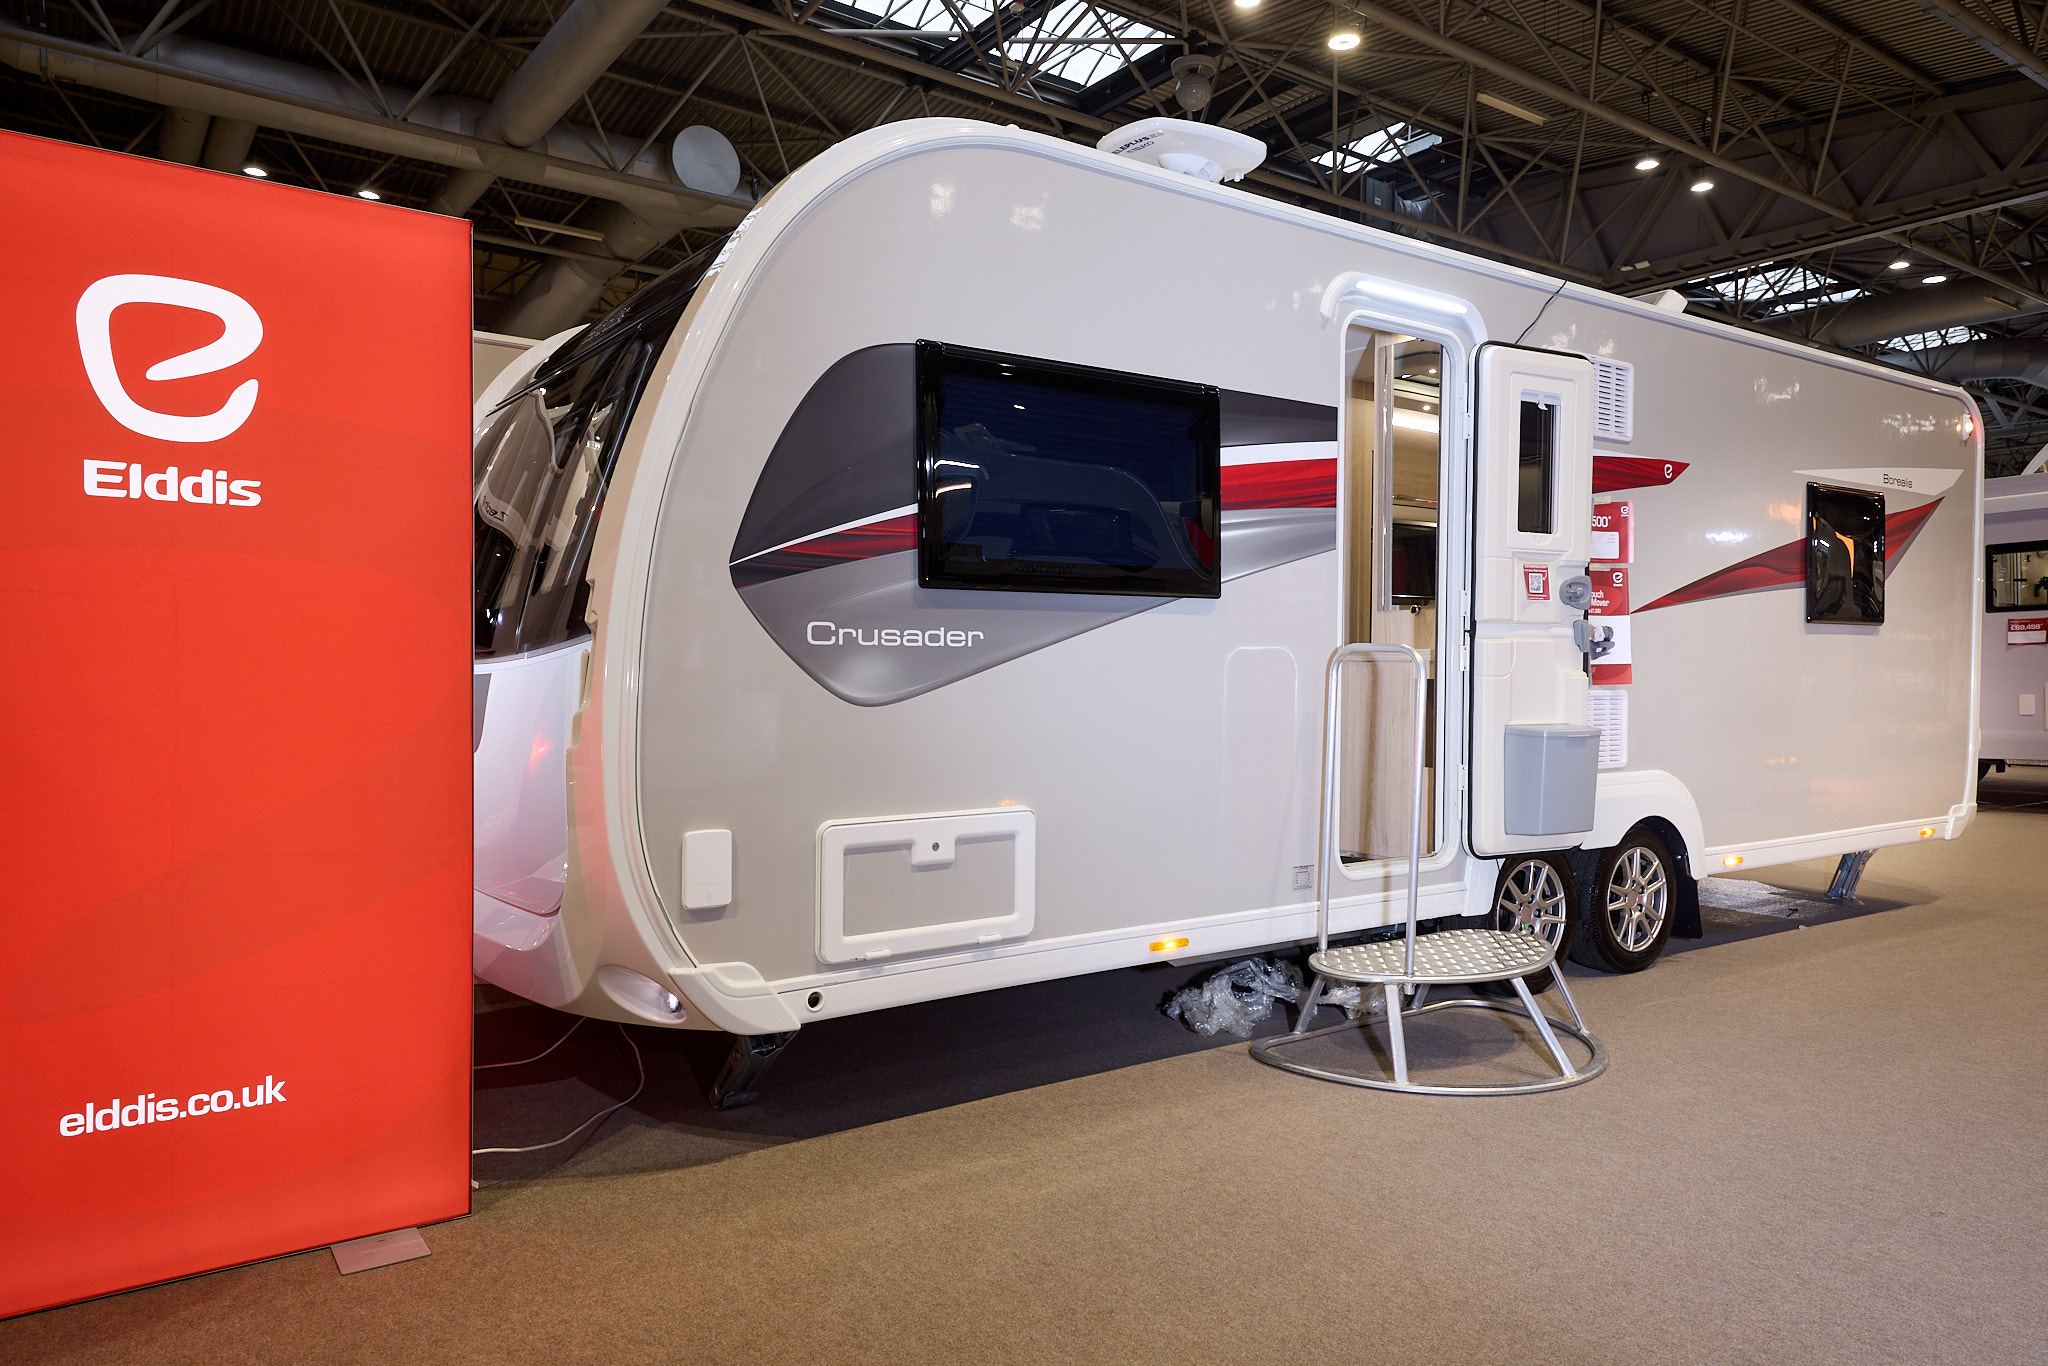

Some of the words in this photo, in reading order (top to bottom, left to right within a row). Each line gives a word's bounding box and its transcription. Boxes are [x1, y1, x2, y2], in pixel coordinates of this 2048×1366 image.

[1111, 136, 1150, 154] ELEPLUS
[83, 458, 262, 507] Elddis
[1883, 473, 1913, 489] Borealis
[806, 621, 984, 647] Crusader
[59, 1075, 287, 1137] elddis.co.uk
